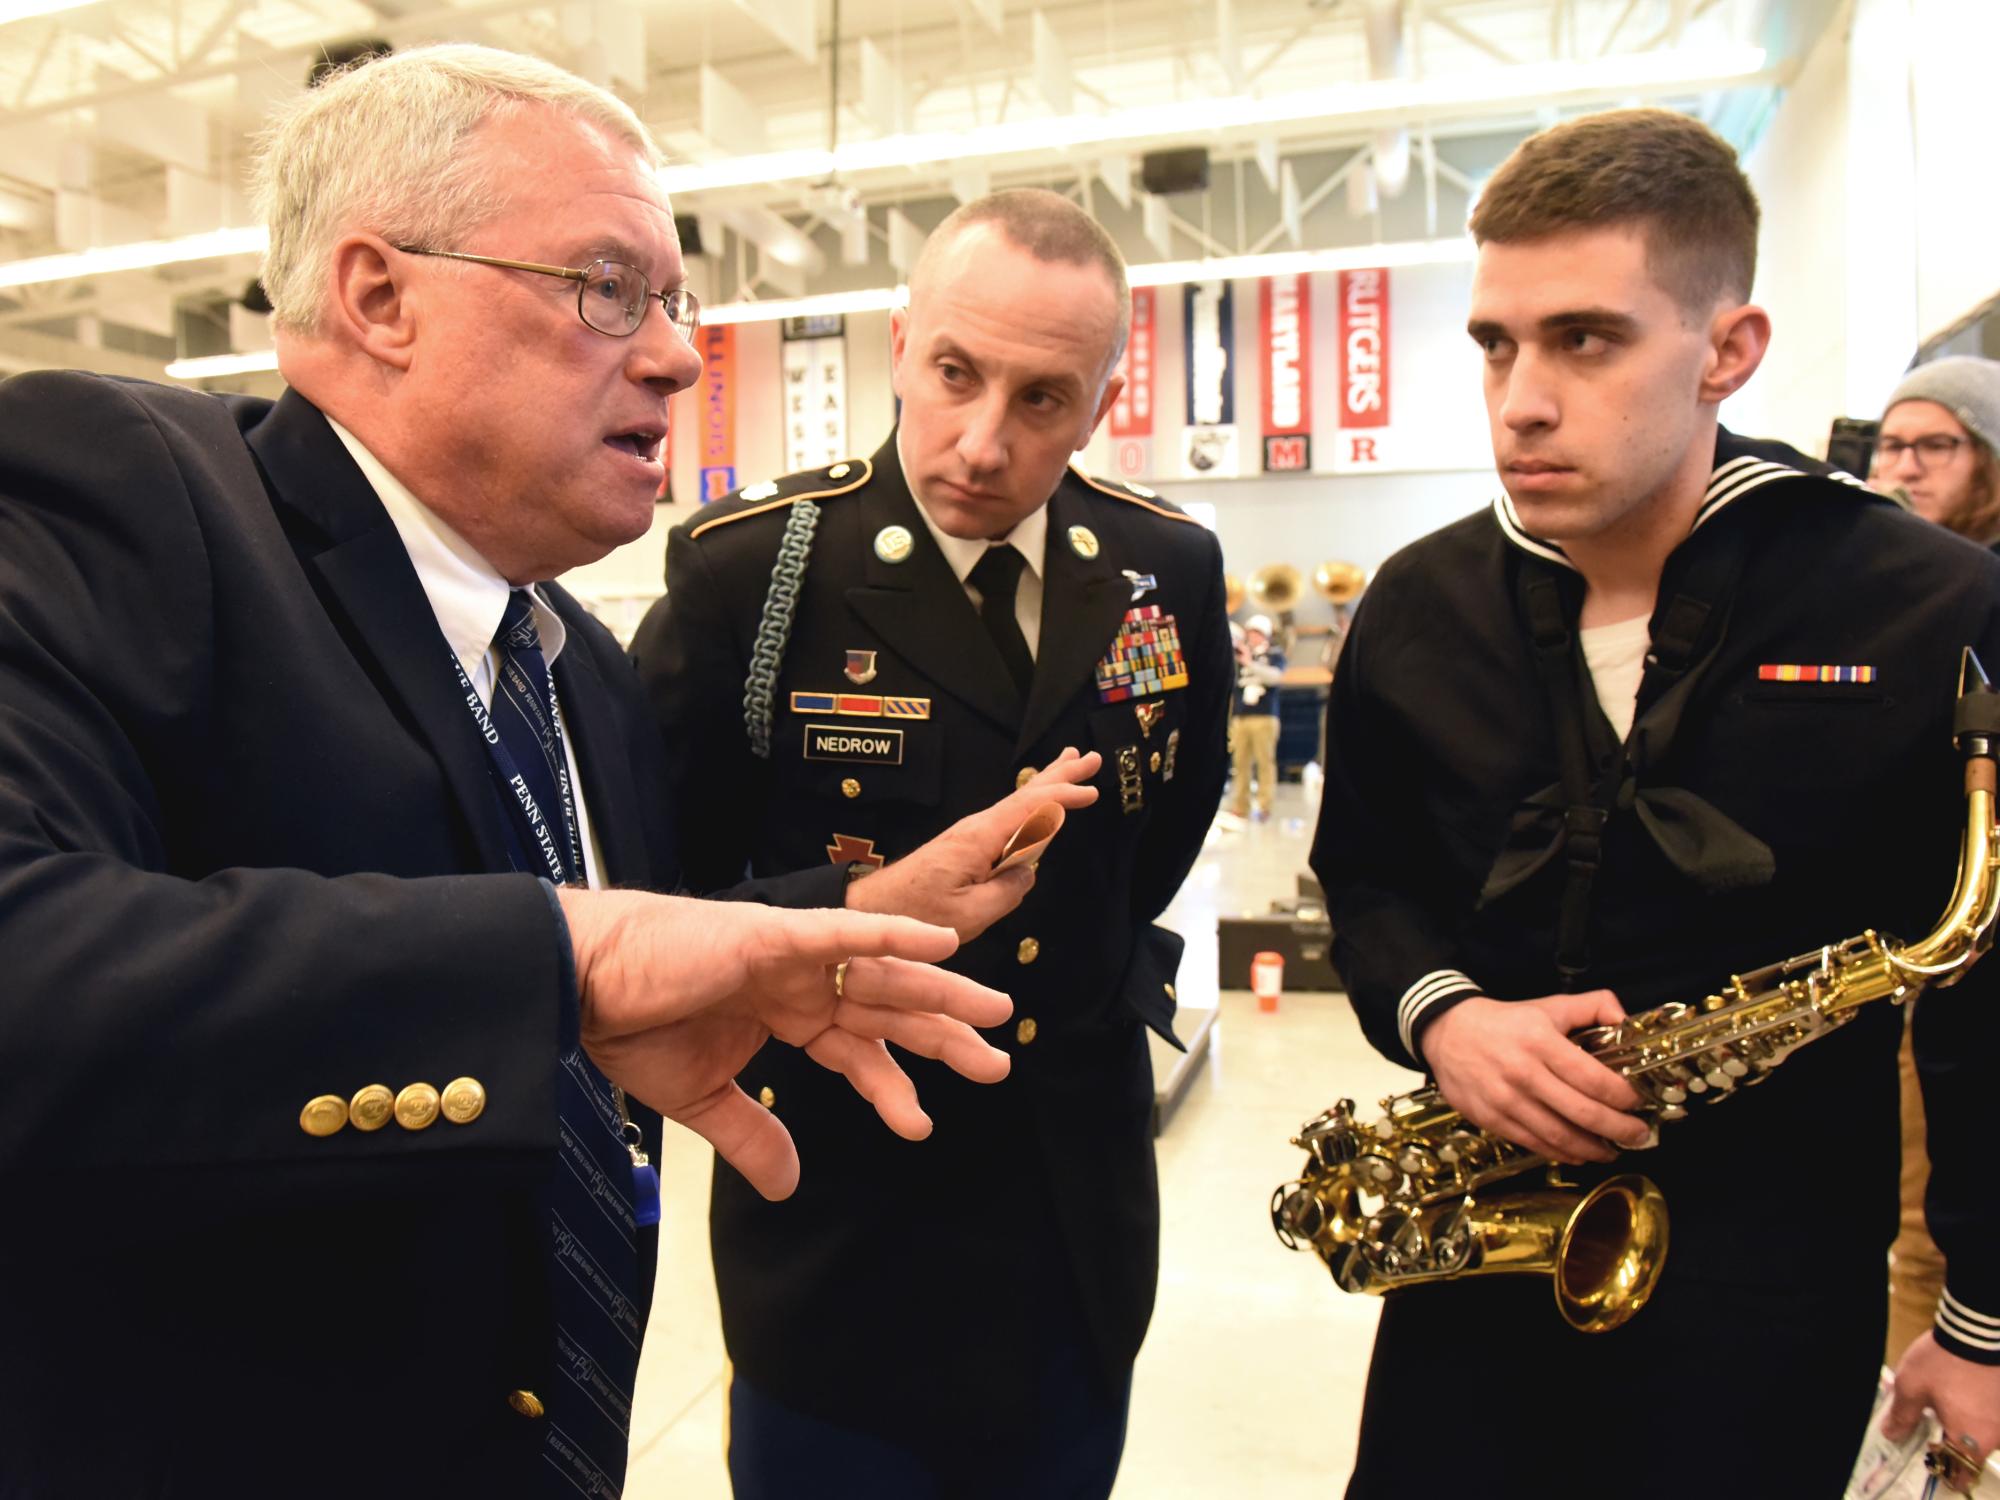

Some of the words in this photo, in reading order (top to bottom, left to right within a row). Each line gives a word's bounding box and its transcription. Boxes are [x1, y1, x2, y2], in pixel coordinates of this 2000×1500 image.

[1347, 271, 1381, 414] RUTGERS
[1350, 437, 1378, 463] R
[465, 691, 500, 746] BAND
[816, 736, 891, 755] NEDROW
[510, 773, 541, 826] PENN
[535, 824, 564, 880] STATE
